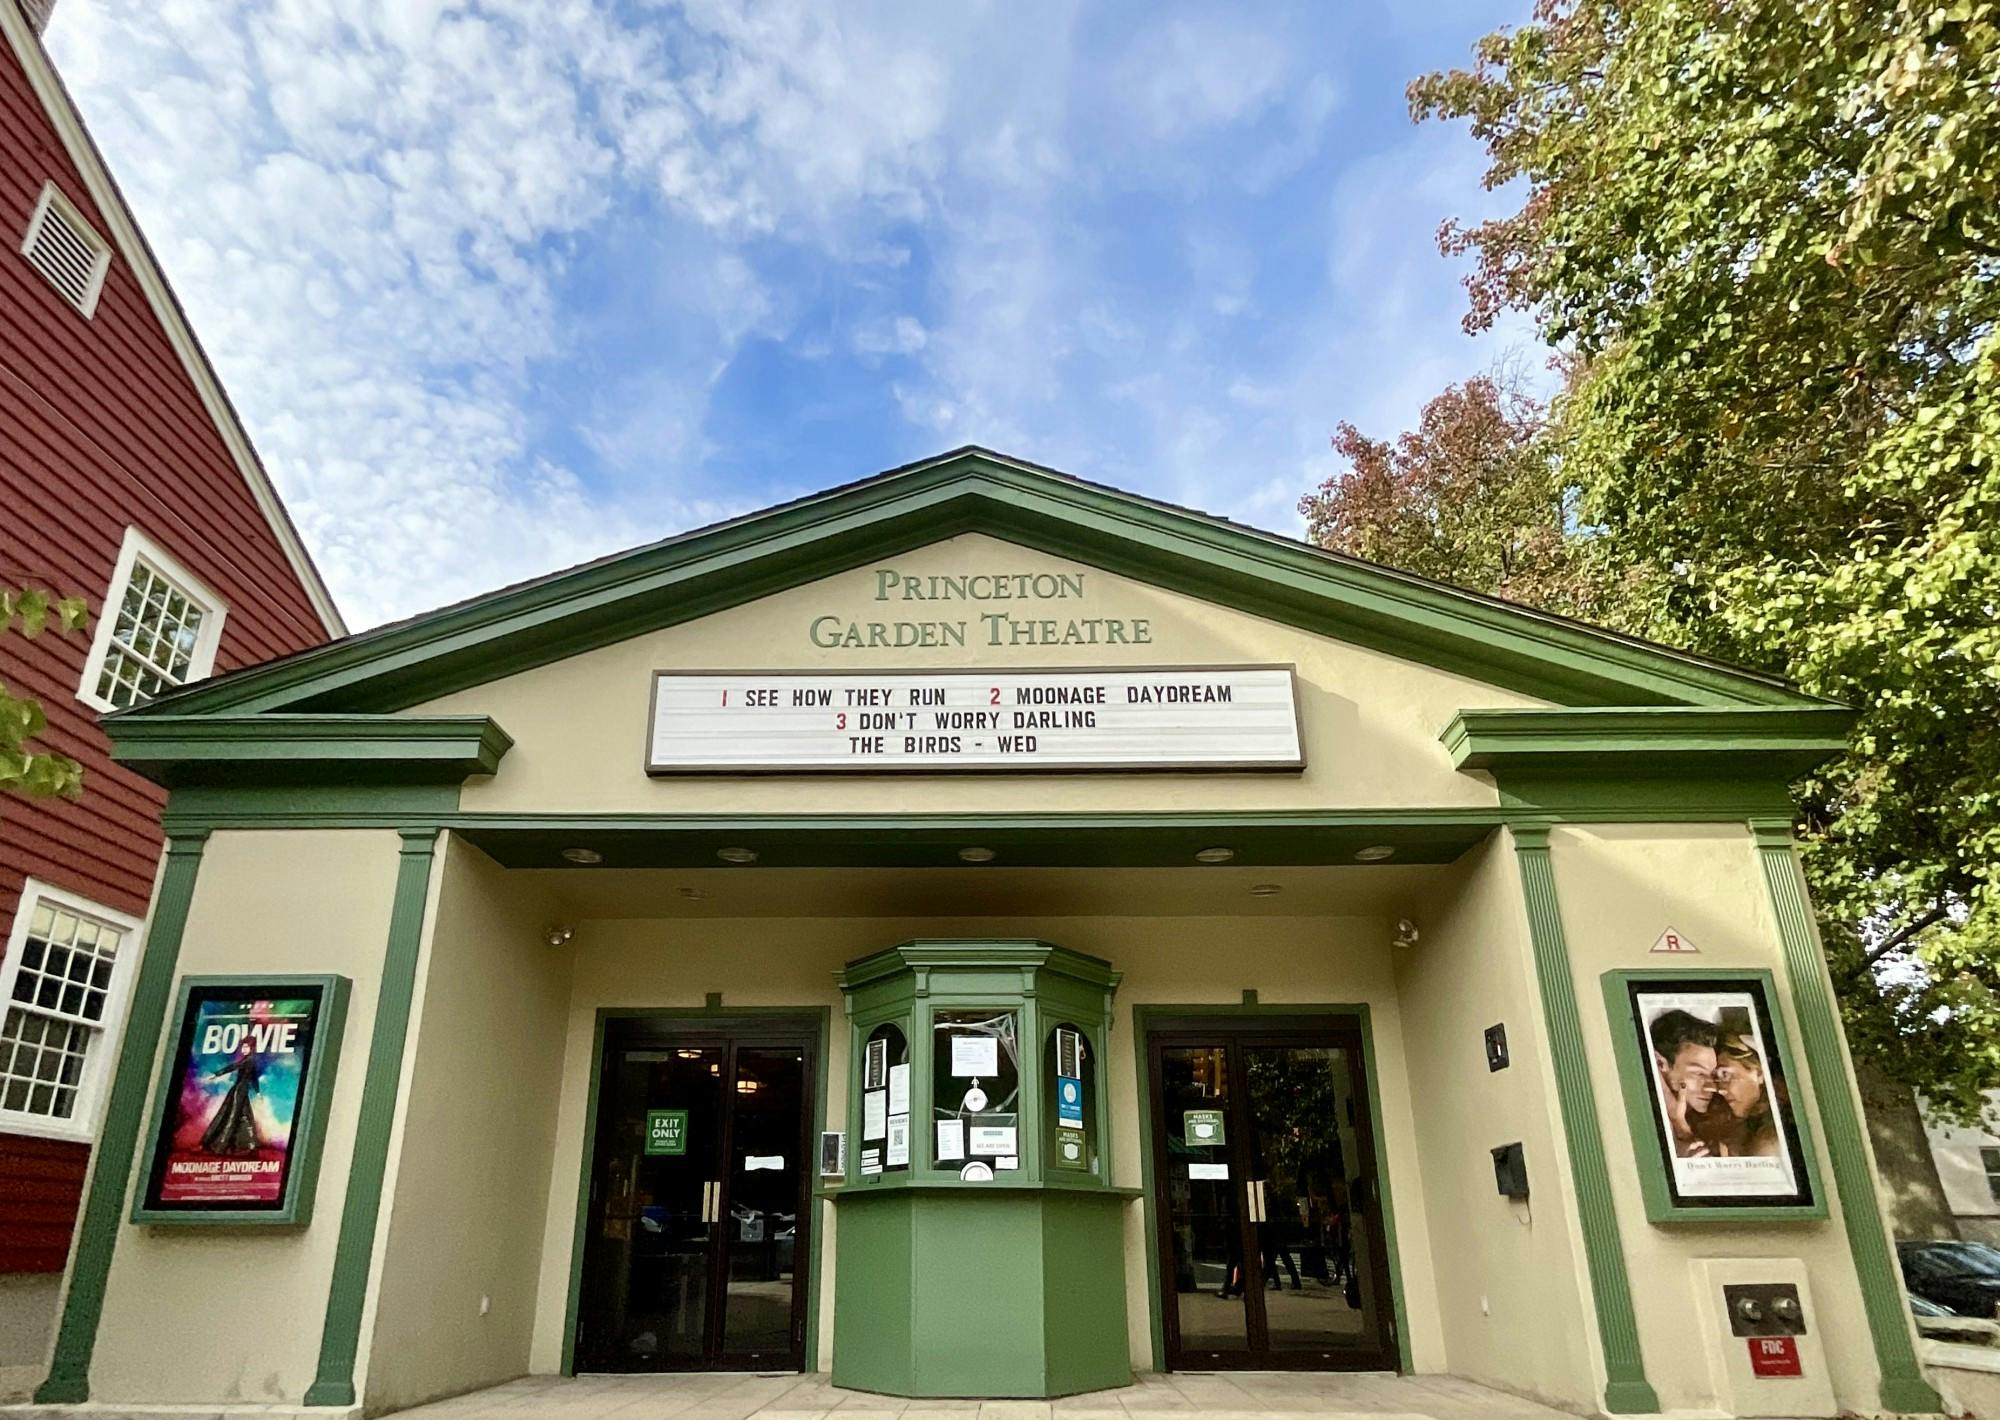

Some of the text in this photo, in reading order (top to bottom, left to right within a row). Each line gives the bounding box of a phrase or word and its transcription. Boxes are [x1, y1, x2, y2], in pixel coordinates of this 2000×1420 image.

[874, 569, 1085, 601] PRINCETON
[809, 612, 1153, 649] GARDEN THEATRE
[745, 689, 779, 707] SEE
[792, 689, 832, 707] HOW
[845, 688, 892, 706] THEY
[909, 688, 946, 706] RUN
[990, 687, 1001, 705] 2
[1016, 686, 1106, 704] MOONAGE
[1127, 685, 1232, 704] DAYDREAM
[836, 711, 1096, 730] 3 DON'T WORRY DARLING
[849, 736, 884, 754] THE
[904, 736, 962, 754] BIRDS
[997, 735, 1037, 753] WED
[1666, 935, 1680, 950] R
[202, 1023, 298, 1055] BOWIE
[652, 1129, 680, 1138] ONLY
[655, 1119, 680, 1129] EXIT
[171, 1160, 280, 1174] MOONAGE DAYDREAM
[1761, 1340, 1785, 1355] FDC
